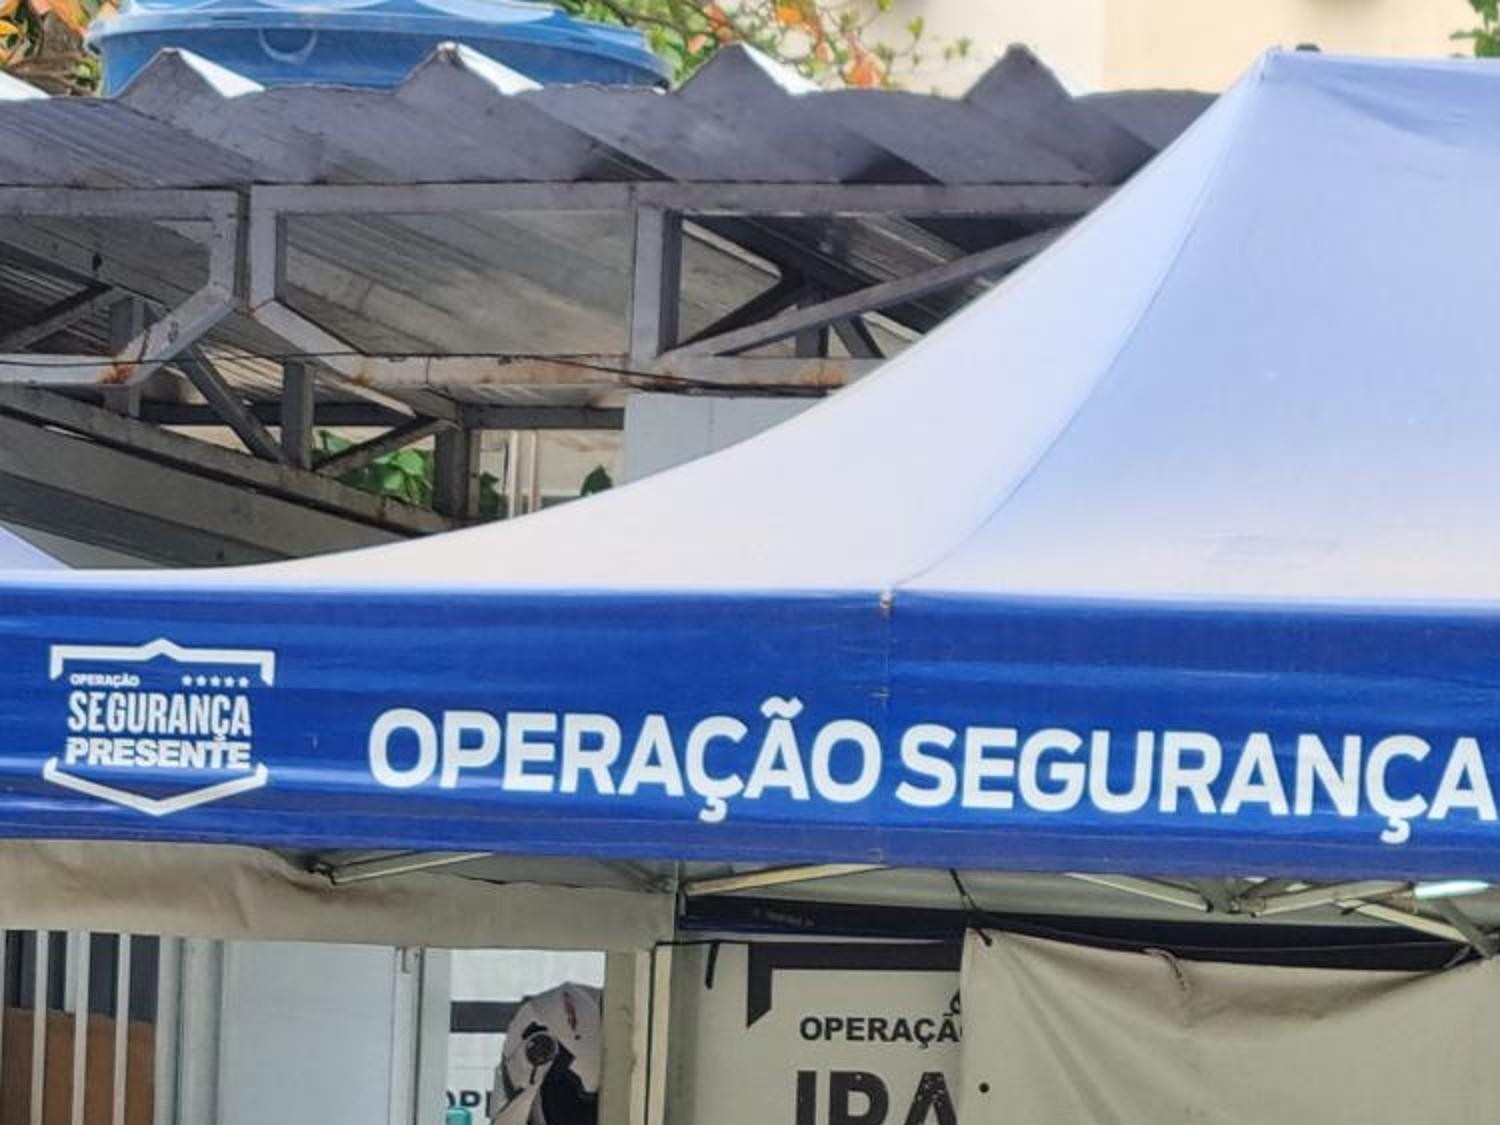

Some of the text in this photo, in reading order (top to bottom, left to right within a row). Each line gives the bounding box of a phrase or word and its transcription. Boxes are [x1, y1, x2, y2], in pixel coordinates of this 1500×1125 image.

[69, 672, 140, 689] OPERAÇÃO
[67, 690, 252, 742] SEGURANÇA
[64, 736, 252, 769] PRESENTE
[368, 697, 882, 822] OPERAÇÃO
[896, 723, 1499, 844] SEGURANÇA
[800, 1014, 962, 1049] OPERAÇÃ
